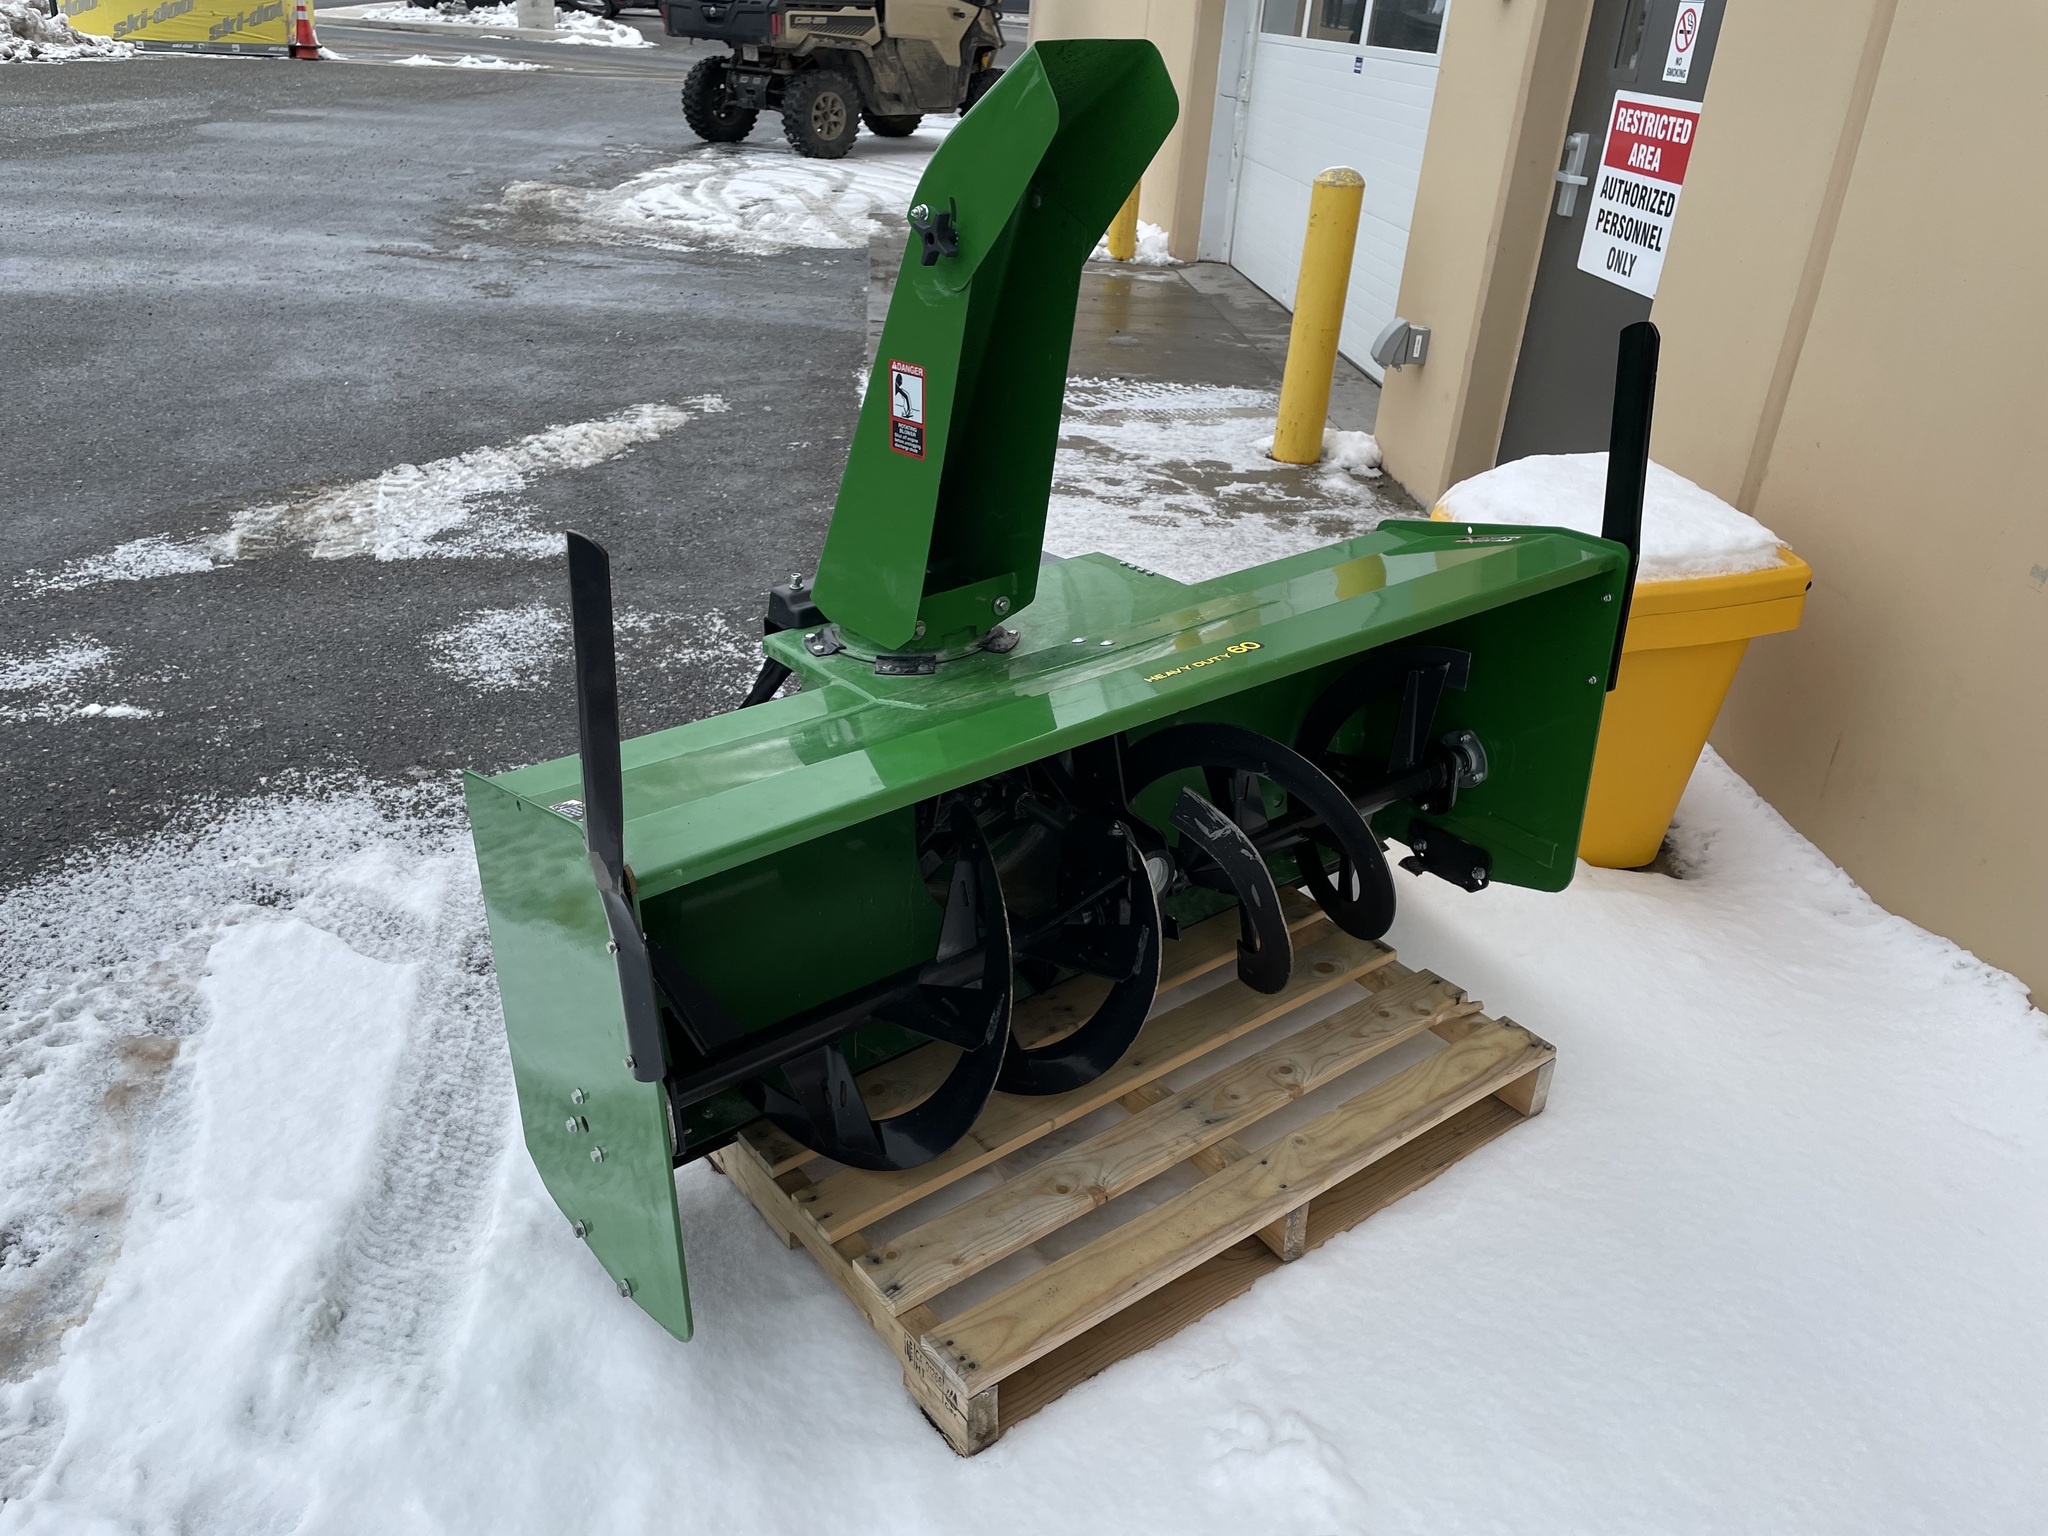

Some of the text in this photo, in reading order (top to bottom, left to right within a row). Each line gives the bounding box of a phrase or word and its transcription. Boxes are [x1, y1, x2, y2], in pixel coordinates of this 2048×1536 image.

[1665, 67, 1687, 79] SMOKING
[1674, 56, 1683, 66] NO
[1615, 107, 1693, 145] RESTRICTED
[1627, 142, 1662, 173] AREA
[1600, 175, 1676, 218] AUTHORIZED
[1595, 208, 1663, 252] PERSONNEL
[1606, 246, 1638, 278] ONLY
[896, 362, 923, 376] DANGER
[1143, 641, 1263, 683] HEAVY DUTY 60
